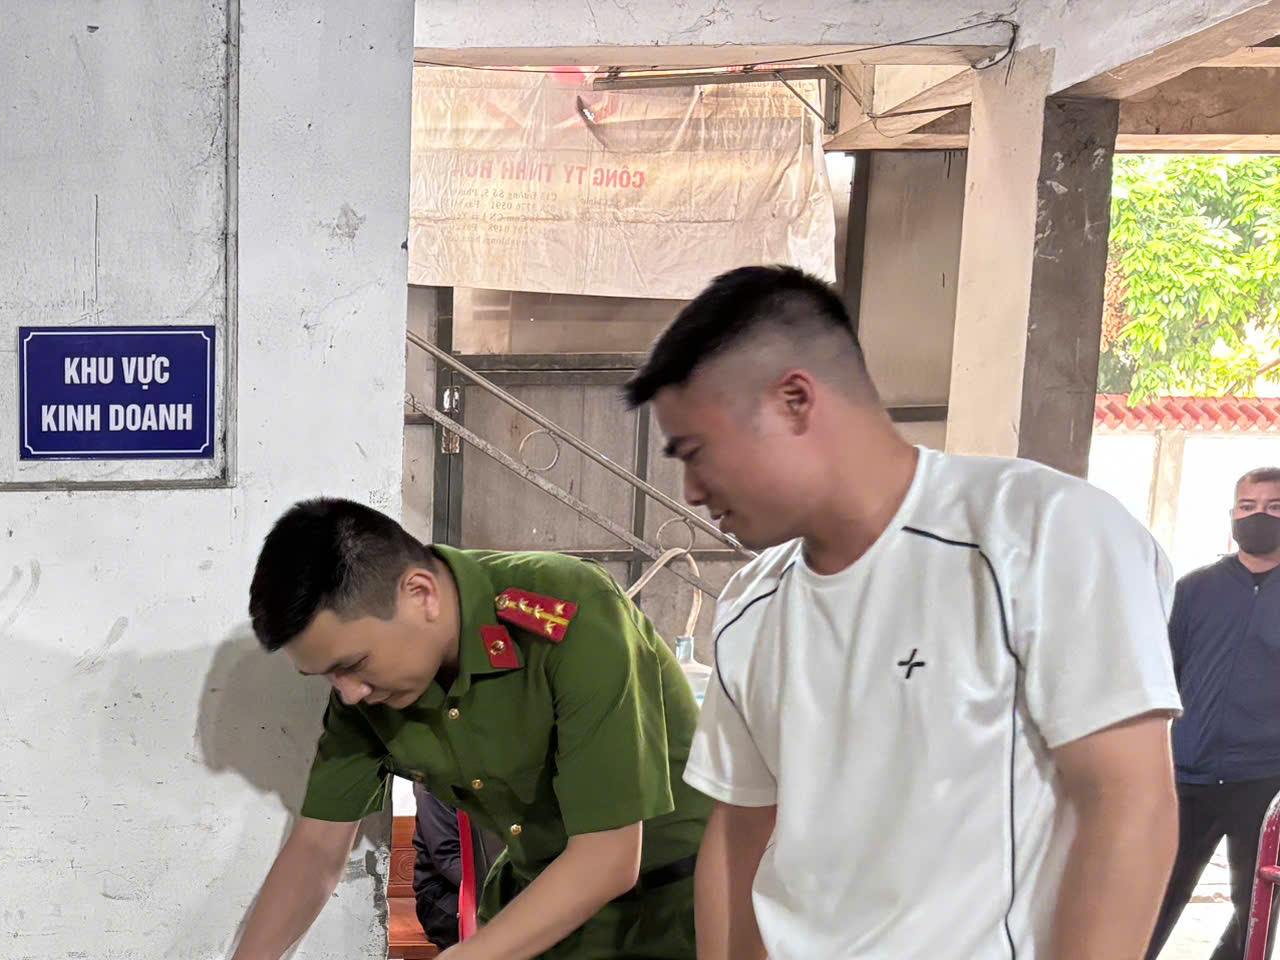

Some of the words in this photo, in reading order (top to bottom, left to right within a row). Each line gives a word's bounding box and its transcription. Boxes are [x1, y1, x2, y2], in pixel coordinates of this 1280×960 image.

[64, 356, 114, 385] KHU
[121, 353, 170, 390] VỰC
[41, 404, 101, 432] KINH
[108, 403, 193, 432] DOANH
